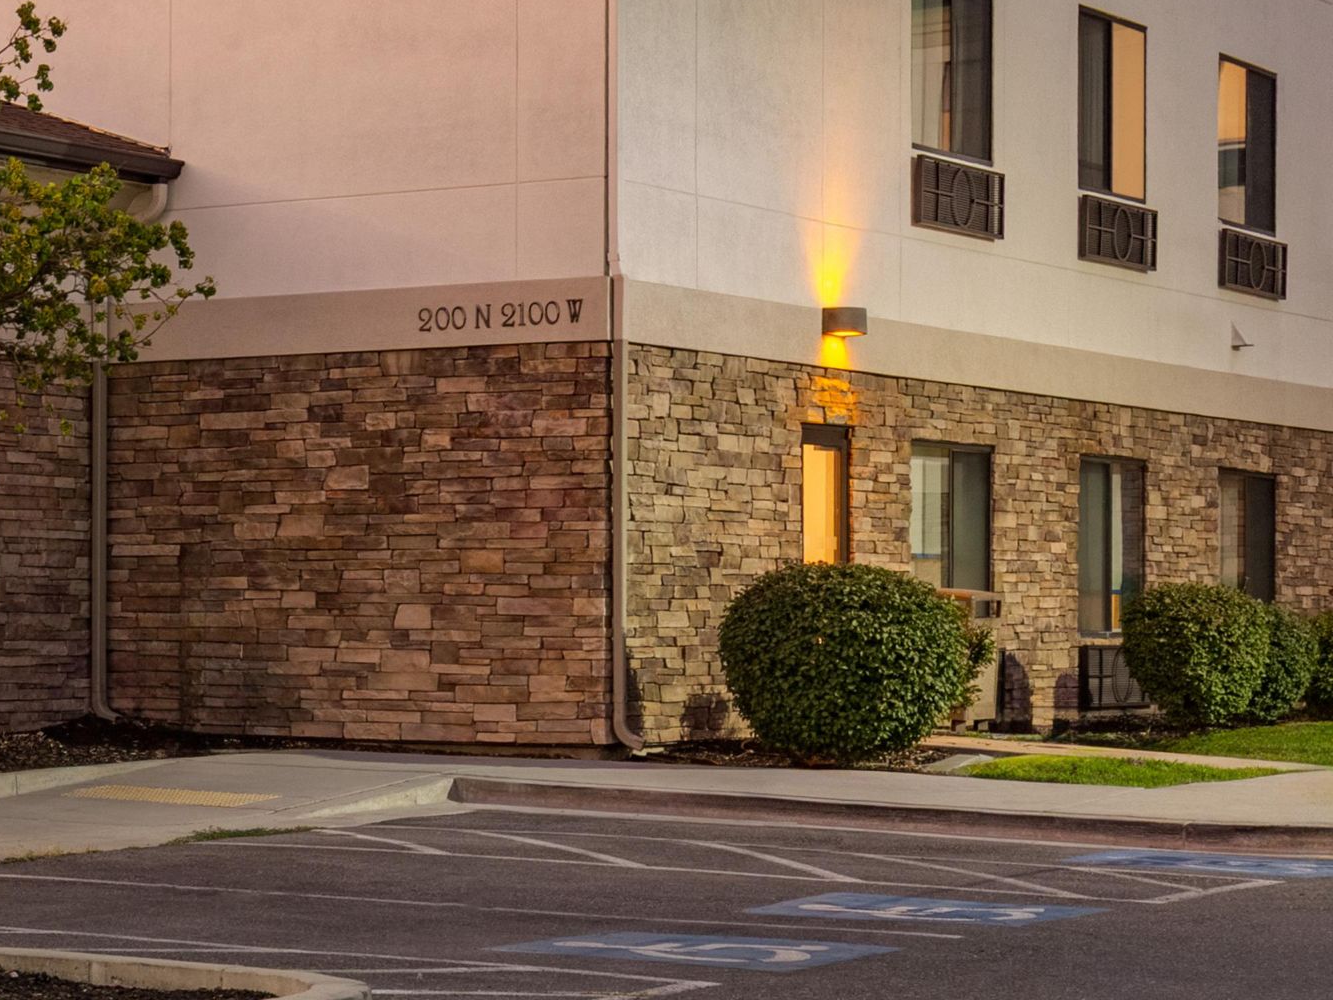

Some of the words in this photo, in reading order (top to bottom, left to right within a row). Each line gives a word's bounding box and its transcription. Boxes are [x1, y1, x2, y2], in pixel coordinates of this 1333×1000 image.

[418, 306, 467, 332] 200
[475, 304, 492, 330] N
[501, 301, 561, 327] 2100
[565, 299, 584, 323] W
